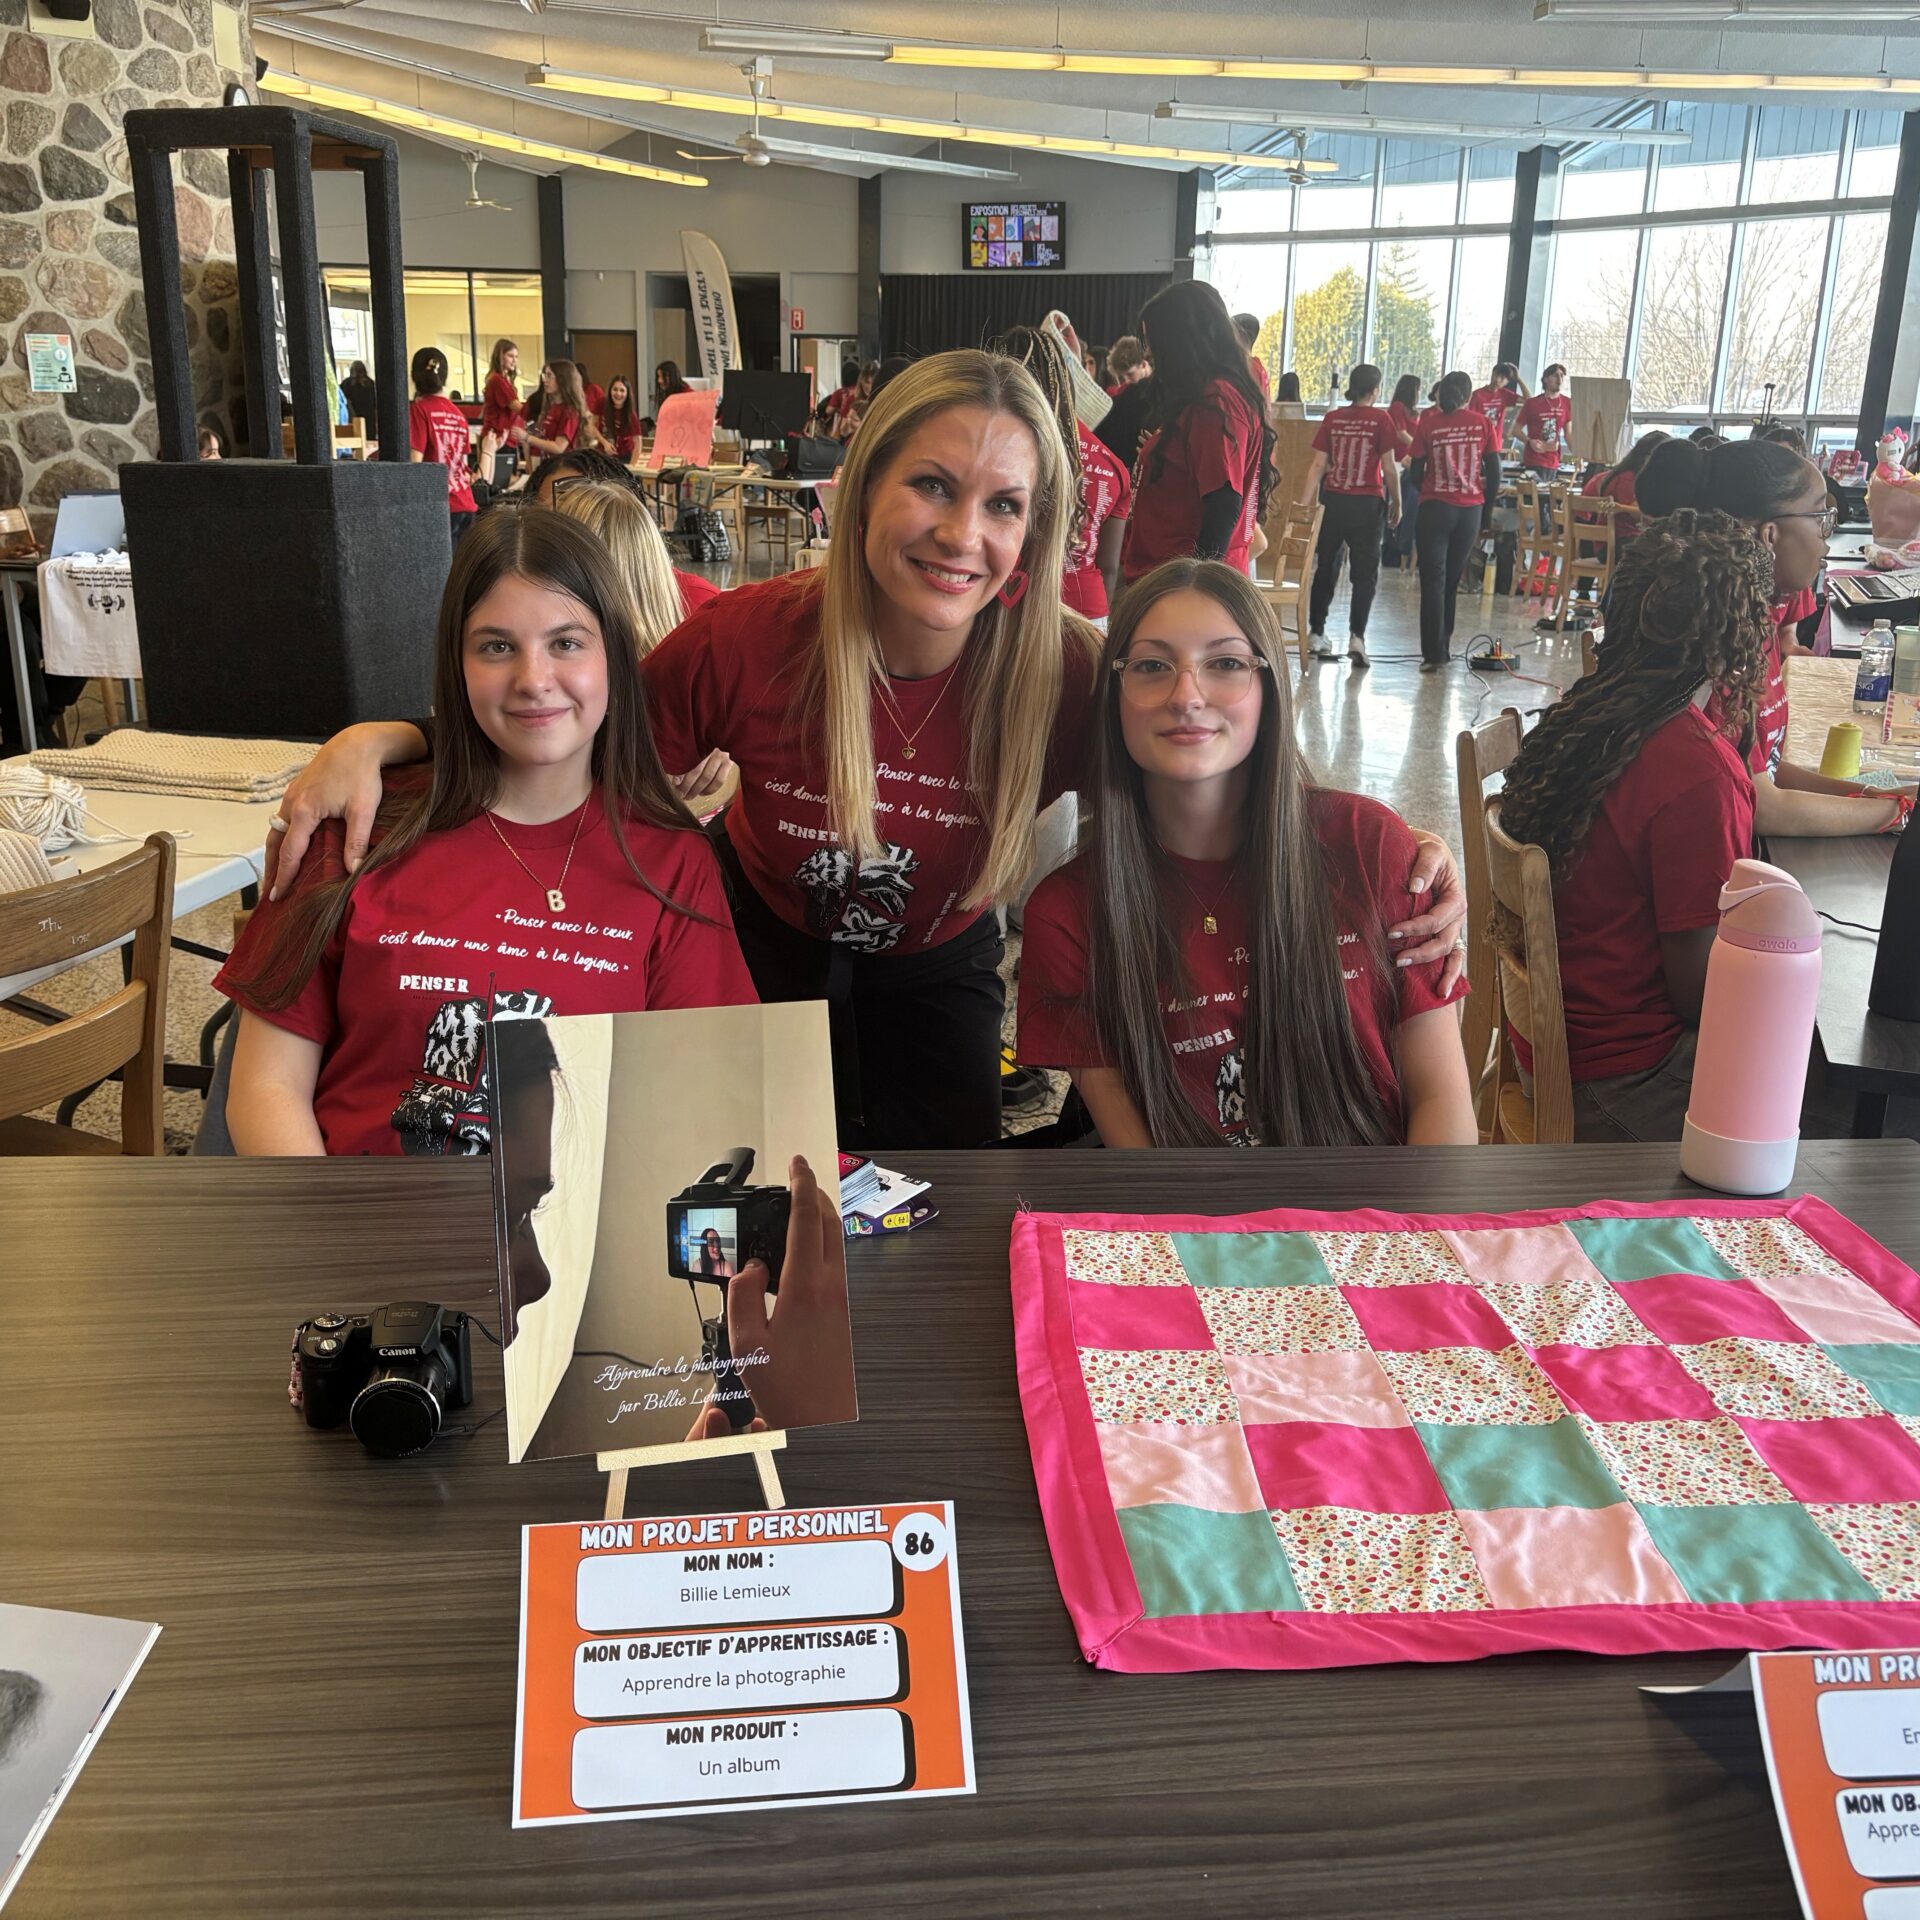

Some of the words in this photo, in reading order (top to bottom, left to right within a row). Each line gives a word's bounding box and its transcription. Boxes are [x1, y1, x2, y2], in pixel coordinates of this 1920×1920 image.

[970, 205, 1009, 216] EXPOSITION
[702, 315, 712, 327] ET
[712, 291, 728, 346] ORIENTATION
[703, 331, 714, 343] LE
[719, 350, 730, 370] DAN
[876, 762, 914, 783] Penser
[919, 773, 946, 788] avec
[949, 775, 961, 790] le
[765, 777, 790, 795] c'est
[793, 784, 829, 805] donne
[901, 801, 912, 817] à
[915, 805, 932, 820] la
[778, 819, 840, 843] PENSER
[551, 920, 582, 933] avec
[585, 921, 599, 935] le
[602, 926, 634, 942] cœur,
[378, 929, 408, 945] c'est
[412, 930, 460, 948] donner
[464, 938, 490, 953] une
[497, 941, 529, 958] âme
[536, 946, 548, 961] à
[552, 948, 569, 963] la
[1758, 938, 1798, 950] owala
[400, 973, 470, 993] PENSER
[1214, 990, 1236, 1003] une
[1172, 1028, 1236, 1055] PENSER
[378, 1347, 416, 1358] Canon
[680, 1346, 771, 1383] photographie
[594, 1358, 671, 1391] Apprendre
[673, 1355, 688, 1376] la
[606, 1401, 641, 1424] par
[643, 1389, 687, 1412] Billie
[689, 1387, 752, 1406] Lemieux
[579, 1523, 633, 1551] MON
[641, 1517, 740, 1548] PROJET
[746, 1509, 889, 1542] PERSONNEL
[904, 1531, 935, 1557] 86
[683, 1554, 723, 1573] MON
[726, 1552, 764, 1570] NOM
[680, 1585, 718, 1603] Billie
[722, 1582, 791, 1600] Lemieux
[583, 1645, 621, 1664] MON
[627, 1637, 713, 1662] OBJECTIF
[718, 1627, 878, 1656] D'APPRENTISSAGE
[621, 1670, 712, 1697] Apprendre
[716, 1670, 731, 1688] la
[735, 1664, 847, 1692] photographie
[1812, 1655, 1873, 1685] MON
[665, 1726, 708, 1746] MON
[711, 1720, 787, 1743] PRODUIT
[699, 1759, 723, 1777] Un
[727, 1754, 781, 1775] album
[1843, 1794, 1886, 1814] MON
[1891, 1792, 1920, 1812] OB
